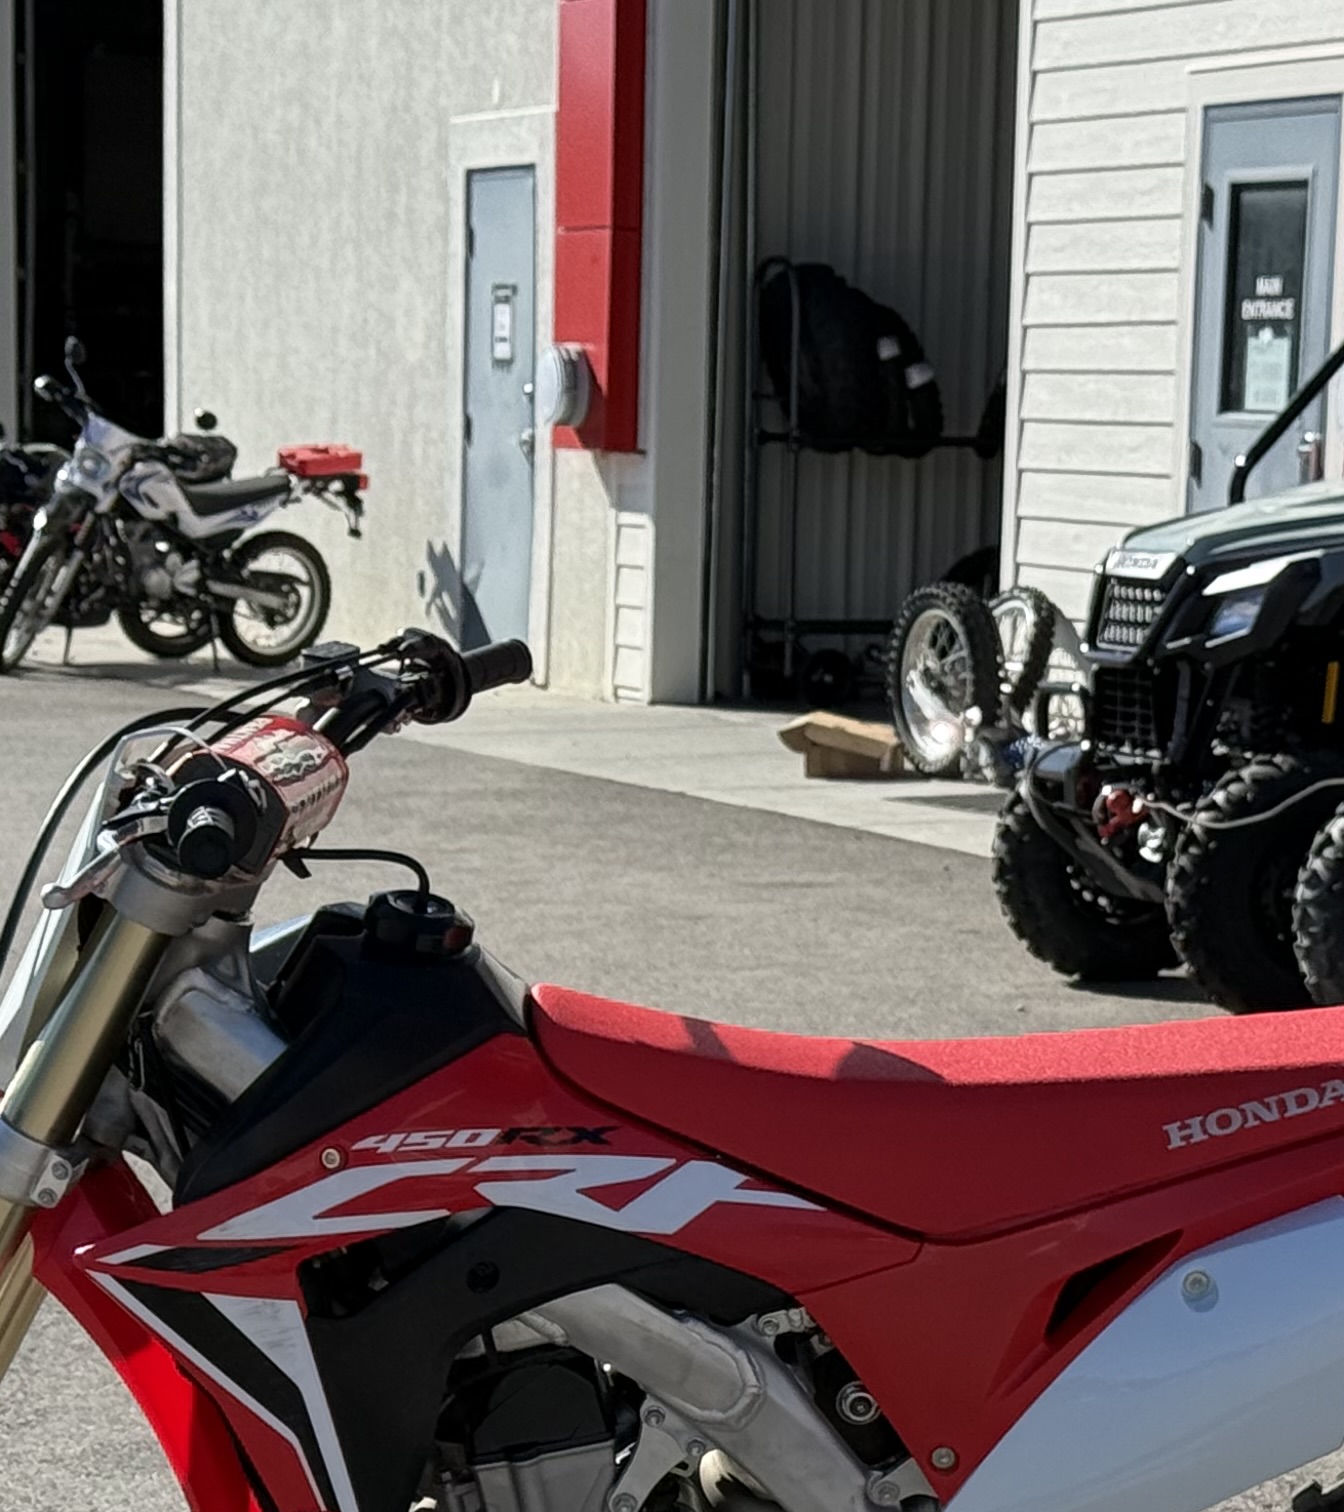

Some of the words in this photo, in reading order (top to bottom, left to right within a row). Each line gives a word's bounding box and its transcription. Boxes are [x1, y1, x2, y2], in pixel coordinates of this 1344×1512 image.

[1241, 298, 1295, 320] ENTRANCE
[351, 1126, 622, 1153] 450RX
[197, 1155, 828, 1241] CRF
